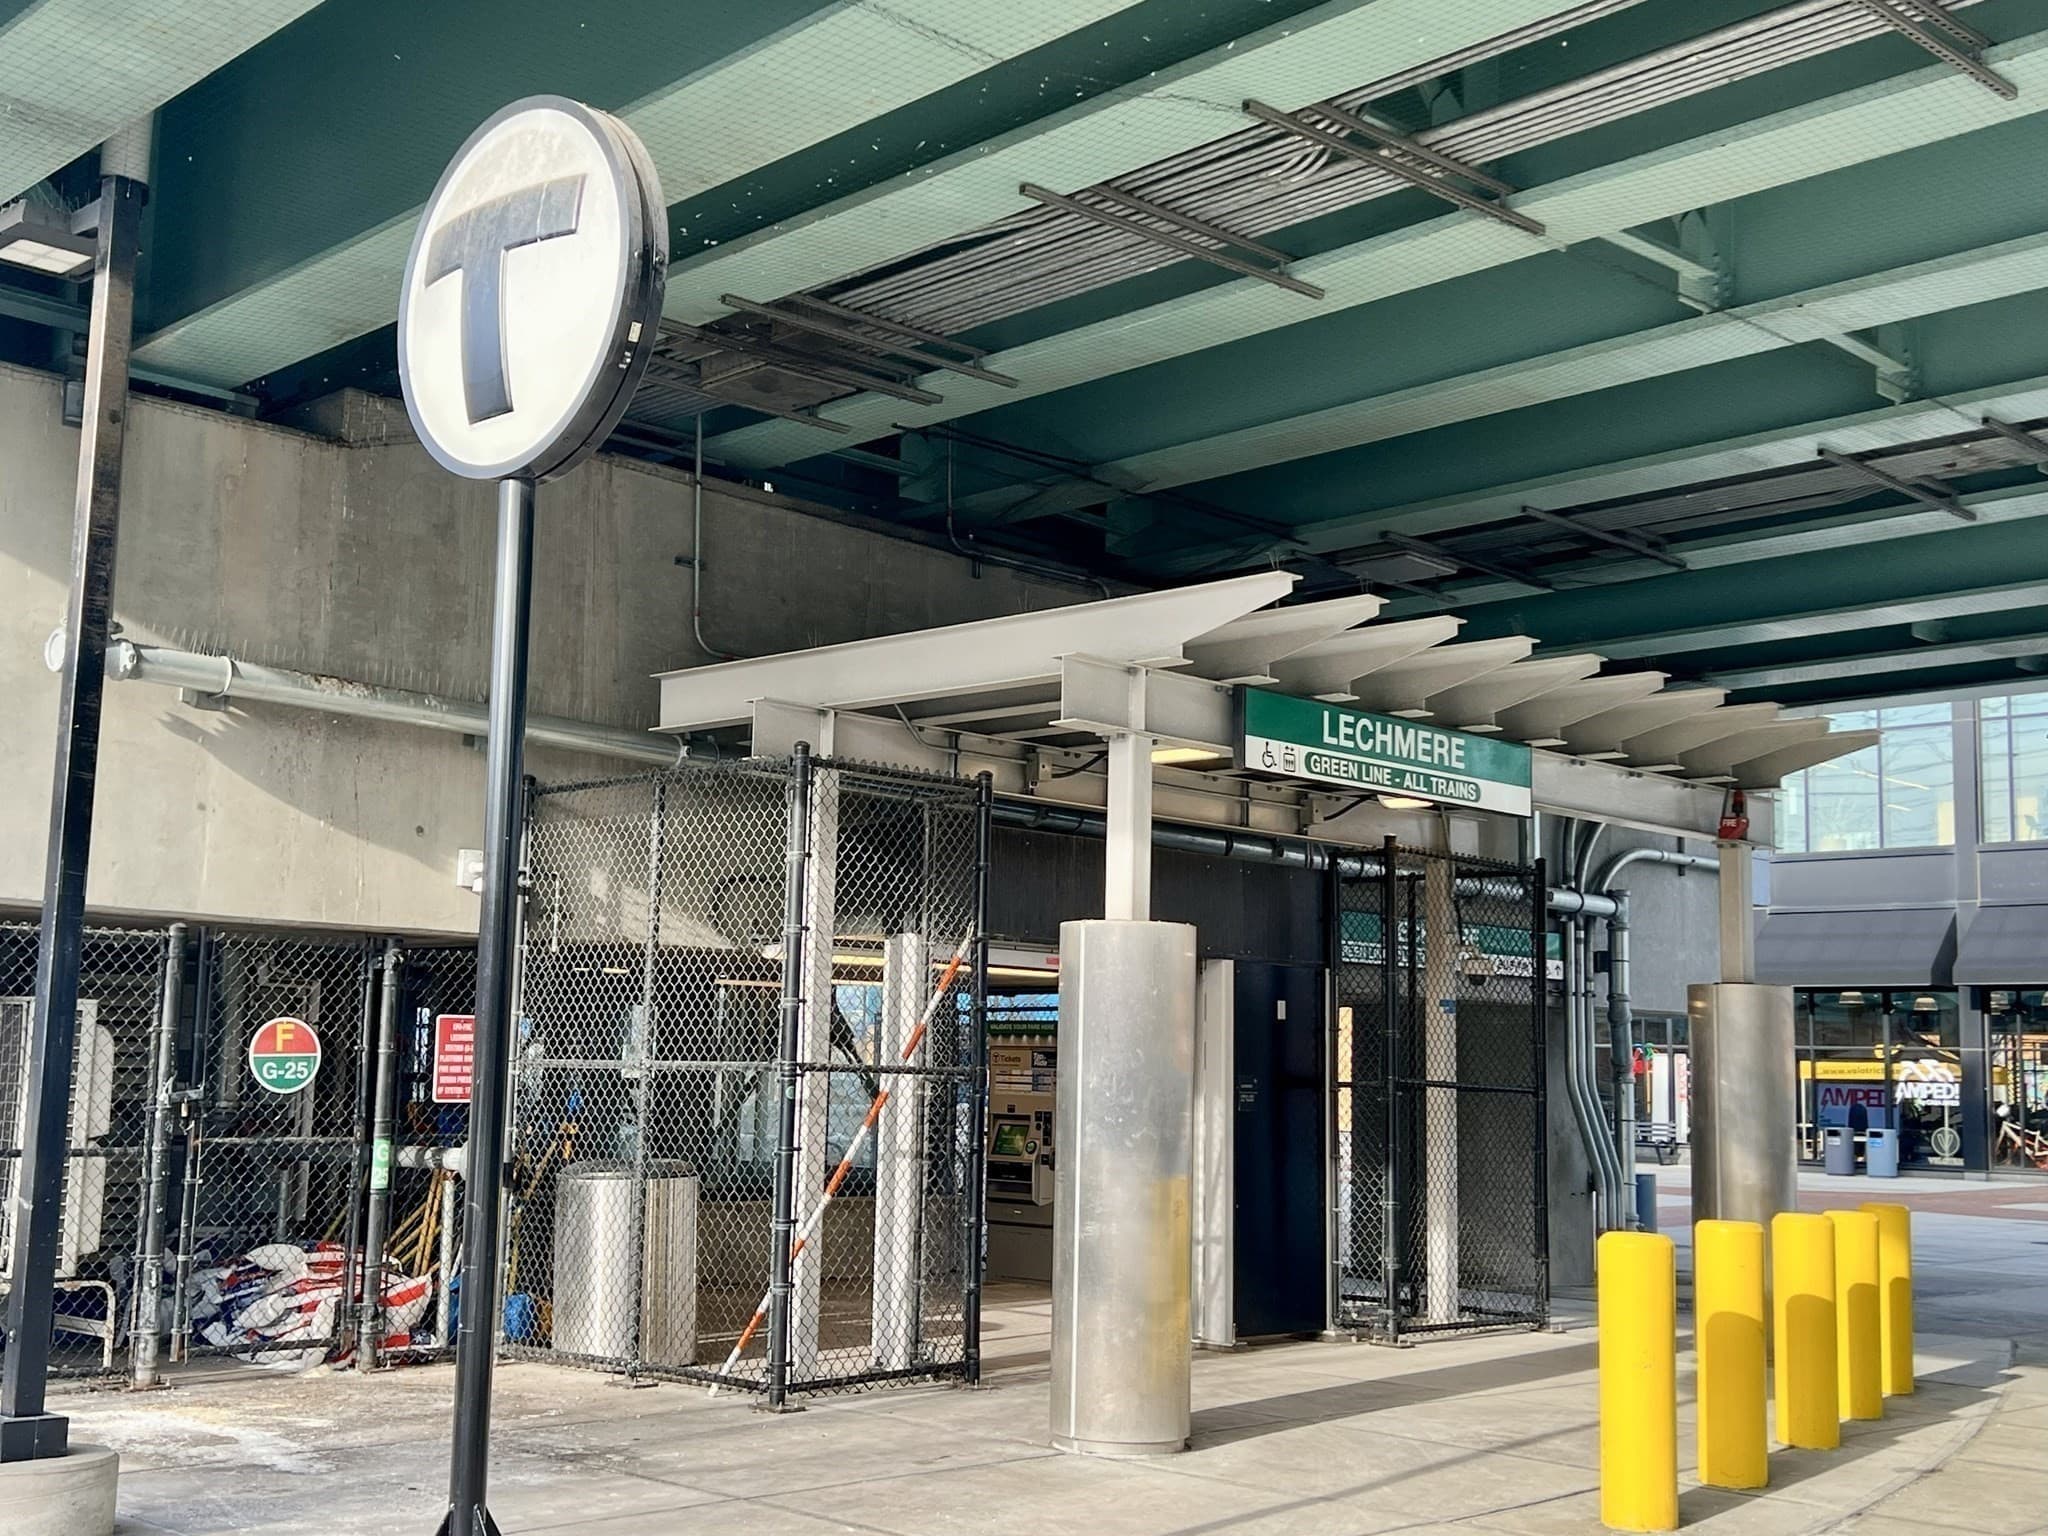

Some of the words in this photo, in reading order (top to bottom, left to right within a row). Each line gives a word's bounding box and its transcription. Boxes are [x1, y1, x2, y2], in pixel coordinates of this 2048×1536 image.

[424, 173, 587, 425] T
[1322, 709, 1466, 770] LECHMERE
[1310, 754, 1358, 780] GREEN
[1362, 765, 1392, 786] LINE
[1403, 774, 1428, 793] ALL
[1430, 777, 1478, 801] TRAINS
[275, 1023, 295, 1052] F
[262, 1061, 309, 1080] G-25
[1821, 1088, 1897, 1110] AMPED
[1896, 1082, 1960, 1103] AMPED!
[377, 1143, 389, 1162] G
